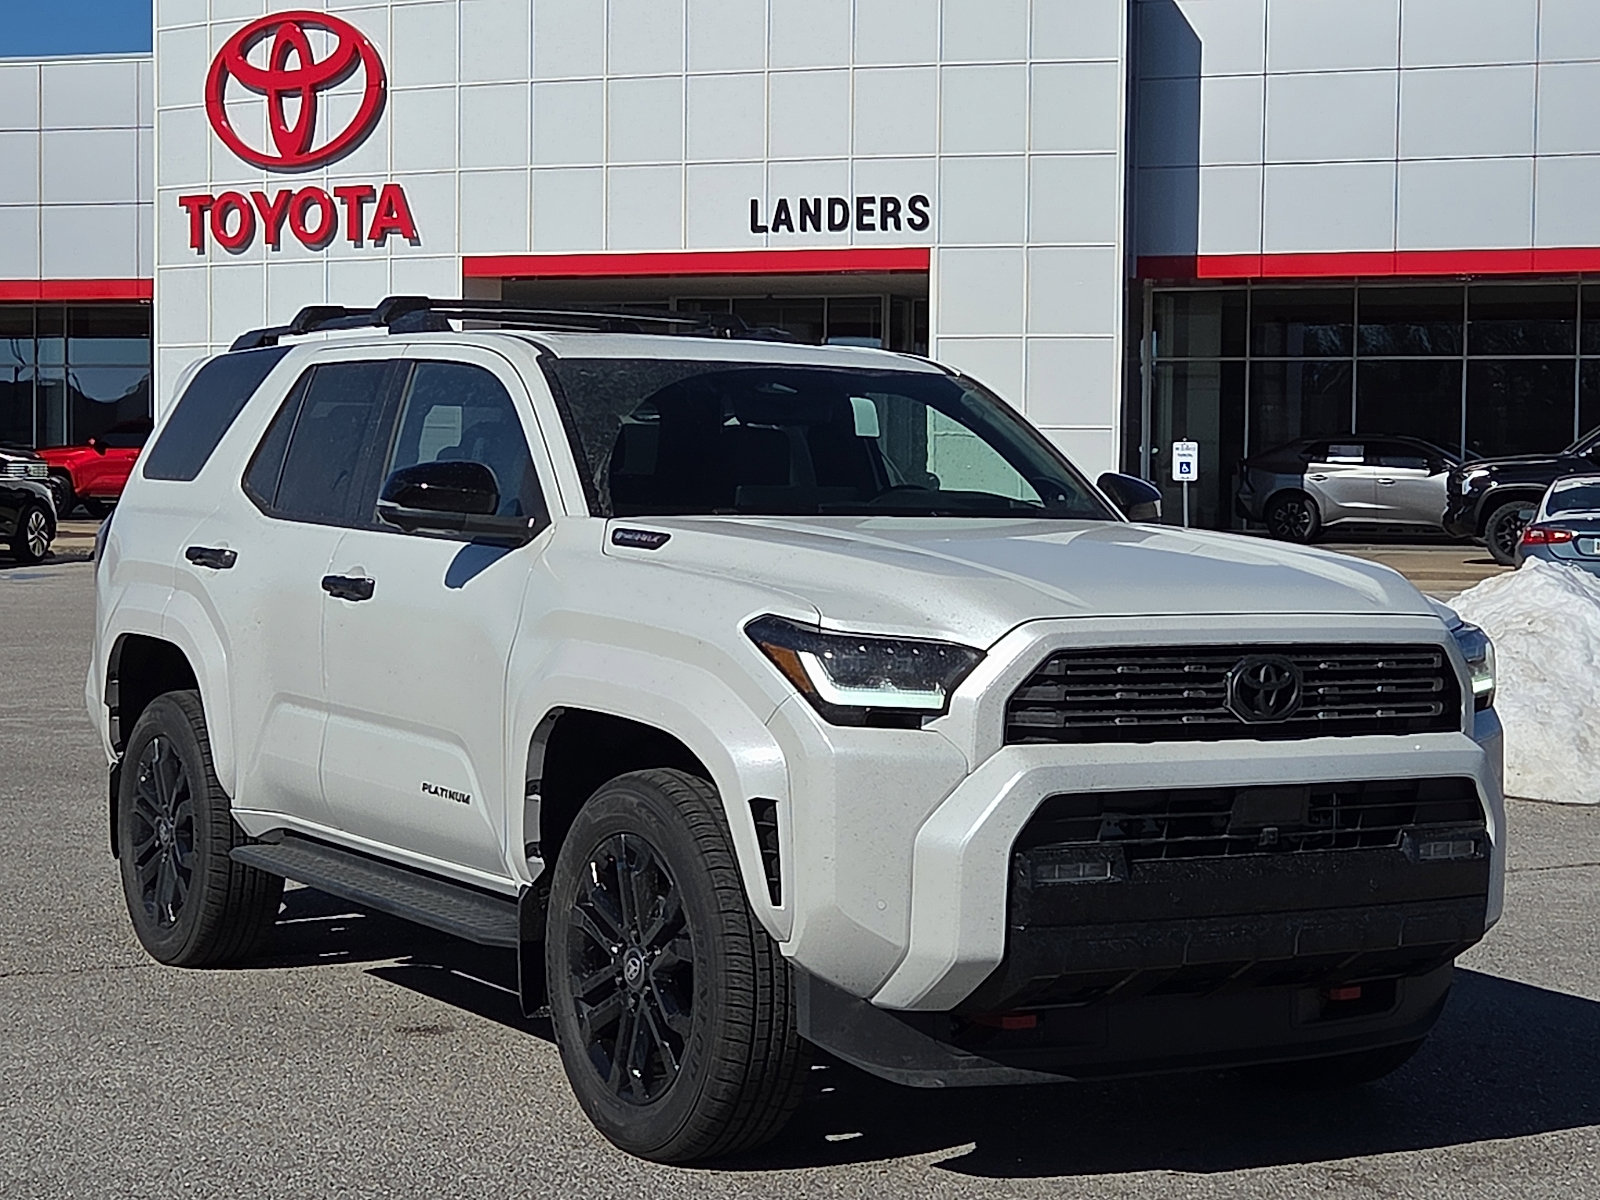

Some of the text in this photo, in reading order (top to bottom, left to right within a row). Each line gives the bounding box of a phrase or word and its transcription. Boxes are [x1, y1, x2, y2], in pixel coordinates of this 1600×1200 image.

[178, 183, 421, 255] TOYOTA
[750, 194, 930, 233] LANDERS
[421, 782, 471, 805] PLATINUM
